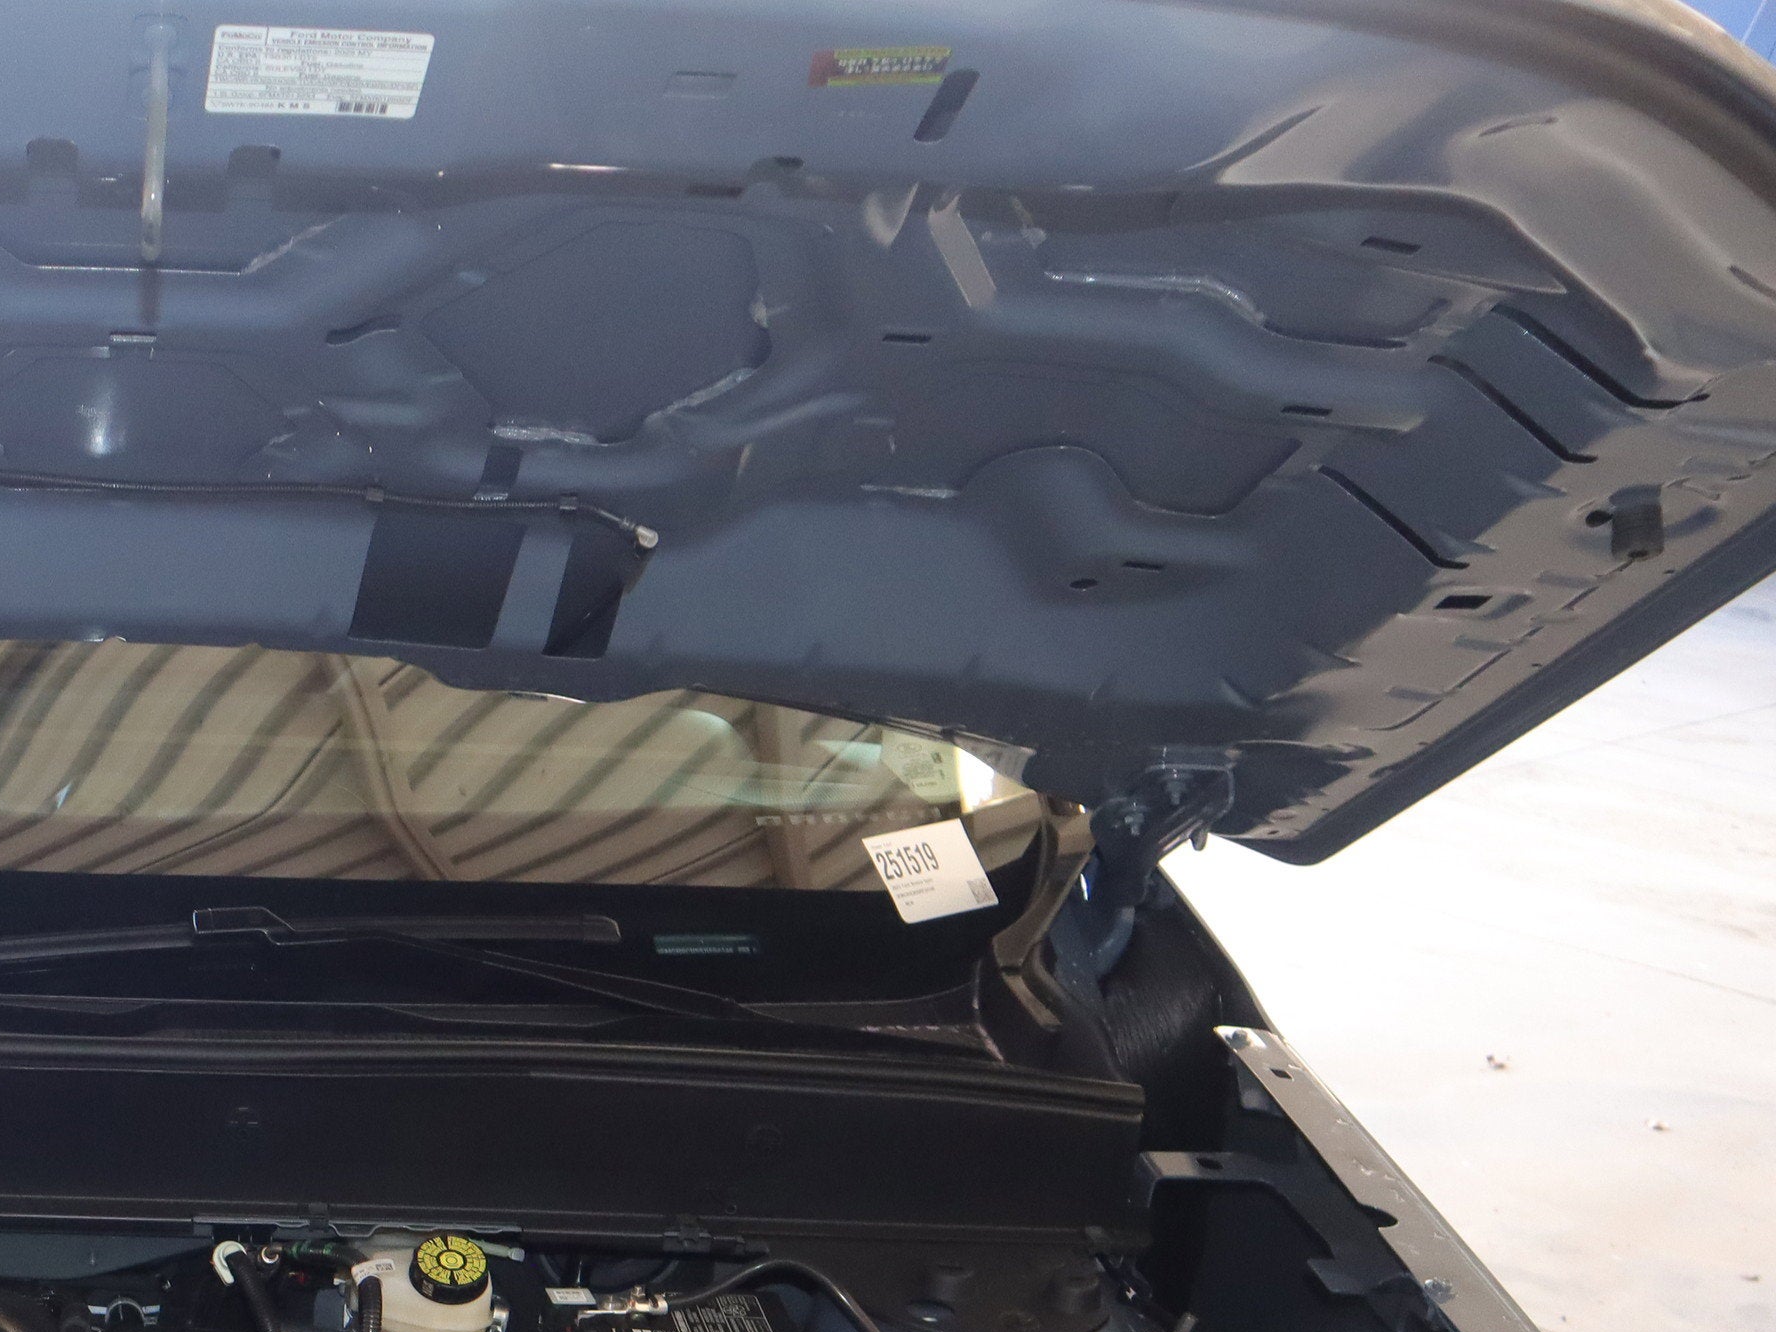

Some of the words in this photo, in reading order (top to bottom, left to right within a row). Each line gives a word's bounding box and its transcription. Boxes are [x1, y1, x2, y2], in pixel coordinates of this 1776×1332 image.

[290, 31, 317, 39] Ford
[321, 32, 353, 41] Motor
[357, 34, 413, 44] Company
[876, 842, 939, 881] 251519
